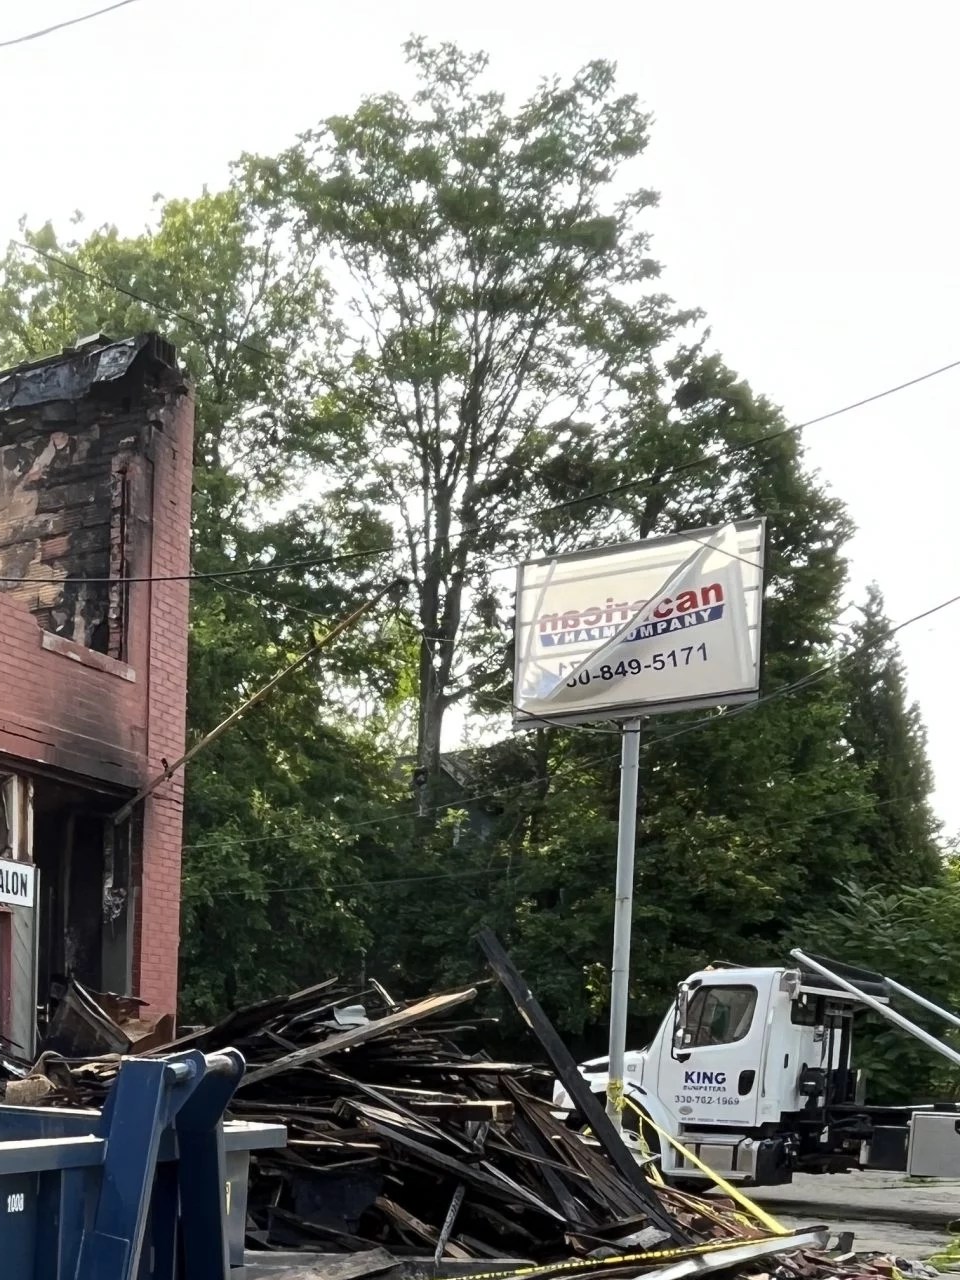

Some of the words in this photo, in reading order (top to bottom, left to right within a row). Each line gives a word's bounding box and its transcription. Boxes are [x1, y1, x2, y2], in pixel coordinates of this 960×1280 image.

[644, 583, 724, 619] can
[626, 608, 712, 641] OMPANY
[684, 1071, 727, 1085] KING
[674, 1095, 740, 1105] 330-762-1969
